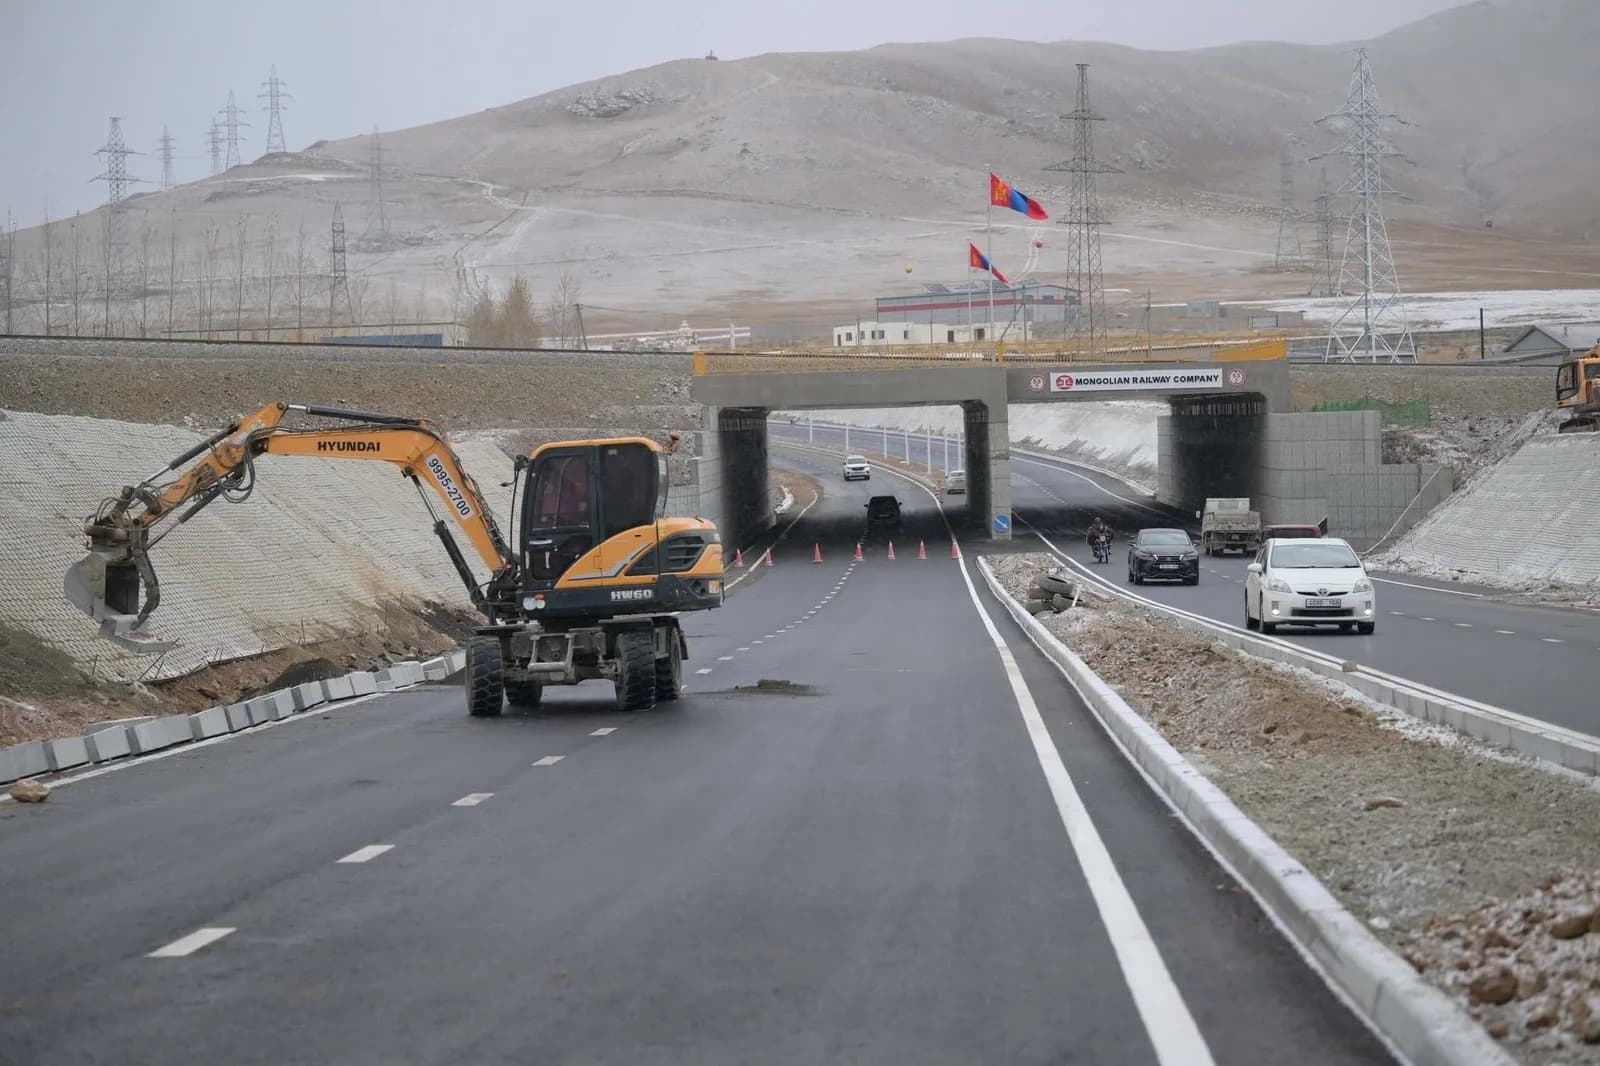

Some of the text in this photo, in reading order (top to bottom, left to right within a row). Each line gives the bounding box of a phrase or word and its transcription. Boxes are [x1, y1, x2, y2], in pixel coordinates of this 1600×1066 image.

[1075, 374, 1219, 386] MONGOLIAN RAILWAY COMPANY
[317, 441, 381, 452] HYUNDAI
[428, 458, 471, 517] 9995-2700
[610, 589, 652, 600] HW60
